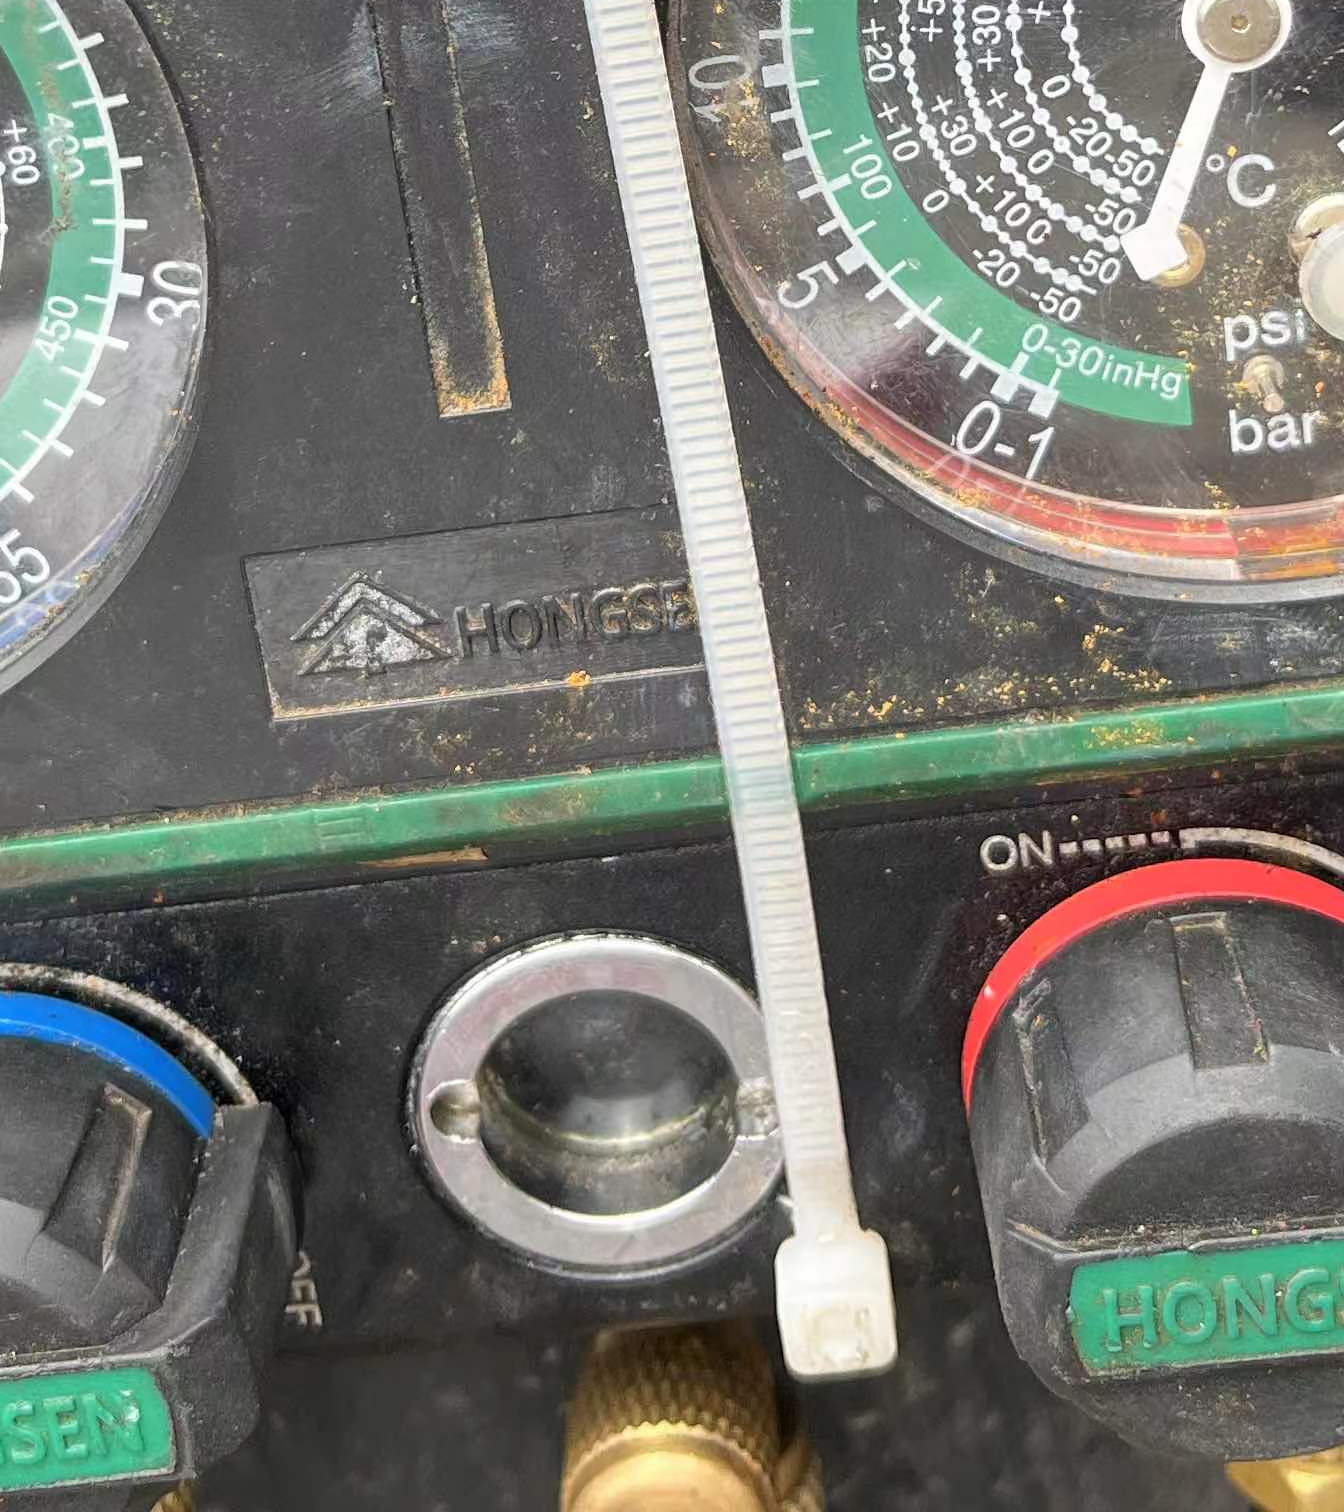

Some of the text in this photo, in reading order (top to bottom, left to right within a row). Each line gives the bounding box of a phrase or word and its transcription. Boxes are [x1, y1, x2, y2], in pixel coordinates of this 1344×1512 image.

[862, 18, 896, 83] +20
[971, 4, 1002, 73] +30
[687, 54, 753, 122] 10
[1042, 75, 1070, 99] 0
[4, 119, 40, 186] +60
[877, 102, 920, 163] +10
[931, 94, 977, 156] +30
[843, 134, 893, 200] 100
[1206, 152, 1278, 209] °C
[922, 190, 950, 214] 0
[1085, 198, 1136, 235] -50
[146, 260, 203, 331] 30
[777, 262, 840, 310] 5
[972, 249, 1021, 287] -20
[1068, 249, 1121, 285] -50
[35, 295, 79, 363] 450
[1030, 287, 1081, 322] -50
[1223, 307, 1306, 362] psi
[1228, 408, 1321, 455] bar
[455, 578, 701, 659] HONGSE
[980, 829, 1053, 875] ON
